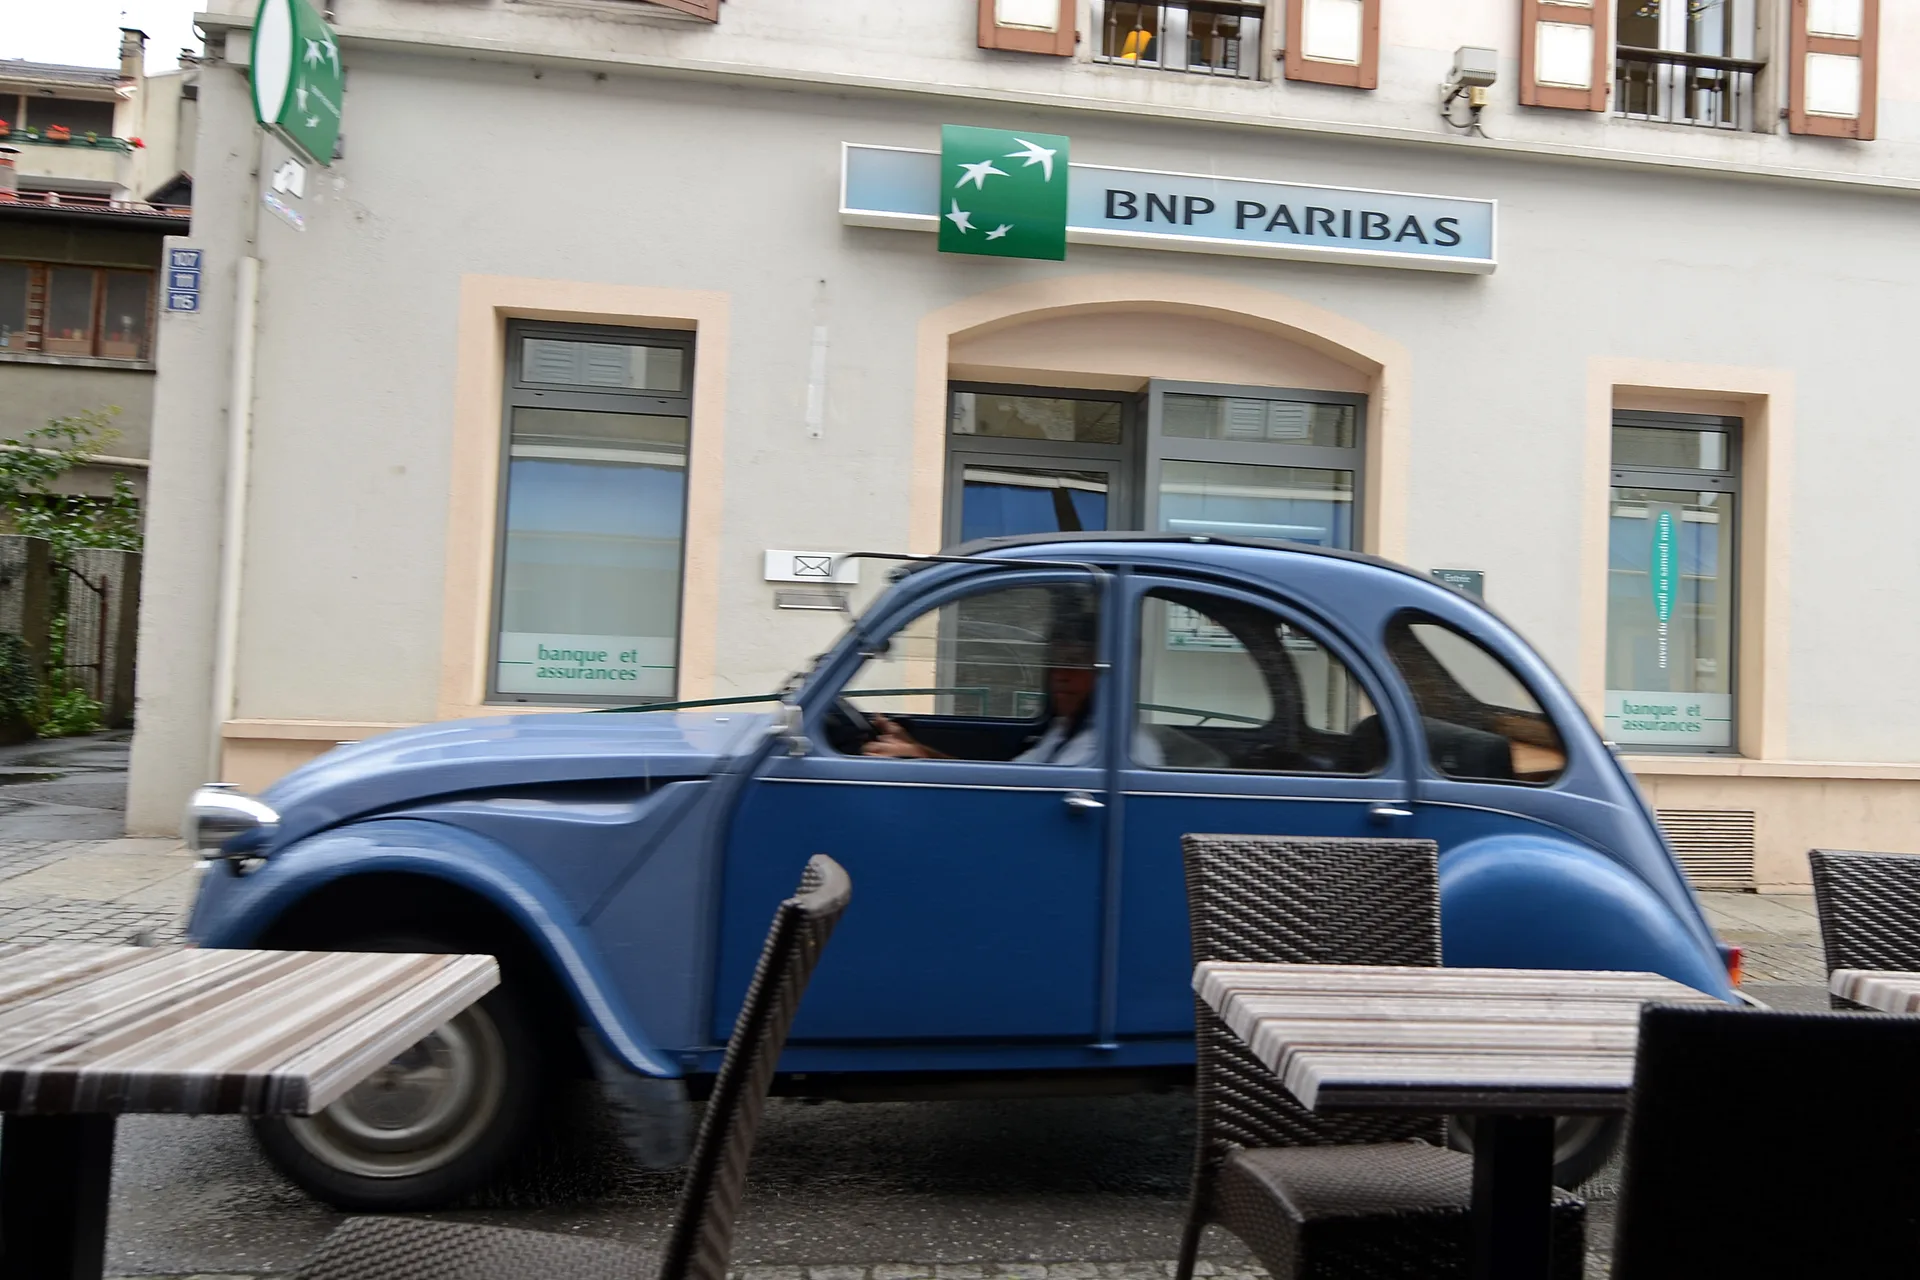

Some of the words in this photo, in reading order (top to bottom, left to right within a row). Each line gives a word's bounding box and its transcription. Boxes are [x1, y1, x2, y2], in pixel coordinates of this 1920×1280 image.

[1105, 189, 1215, 225] BNP
[1236, 200, 1461, 247] PARIBAS
[1658, 513, 1670, 541] matin
[1658, 543, 1669, 577] samedi
[1659, 579, 1669, 591] au
[1657, 593, 1669, 621] mardi
[1657, 622, 1668, 636] du
[538, 644, 608, 666] banque
[619, 649, 638, 664] et
[1657, 637, 1668, 669] ouvert
[537, 667, 637, 680] assurances
[1622, 700, 1678, 720] banque
[1686, 704, 1701, 717] et
[1621, 720, 1702, 732] assurances
